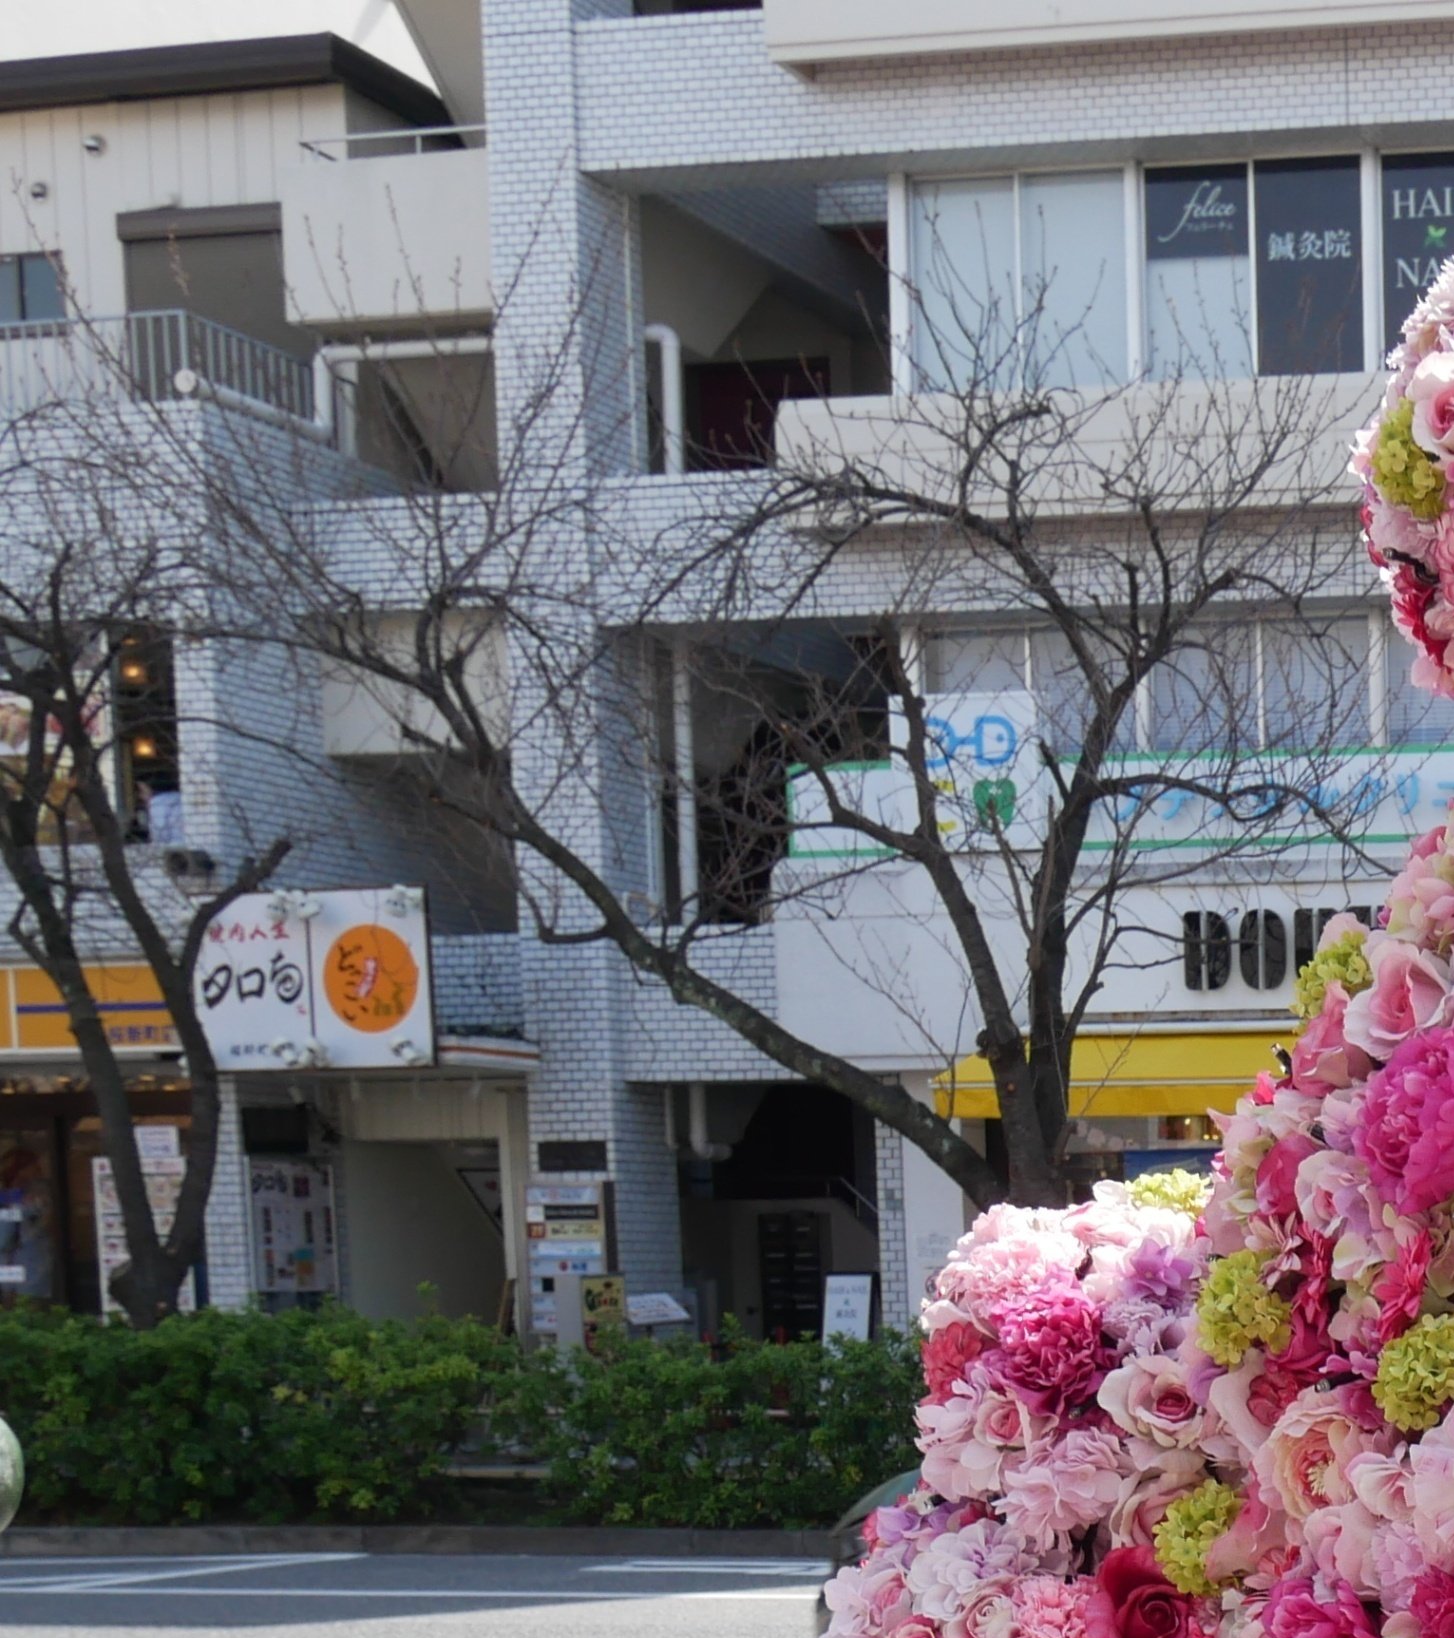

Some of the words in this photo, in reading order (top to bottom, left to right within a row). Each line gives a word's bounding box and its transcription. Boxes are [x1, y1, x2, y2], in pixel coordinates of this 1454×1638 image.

[1157, 180, 1235, 243] felice
[1268, 229, 1352, 261] 鍼灸院
